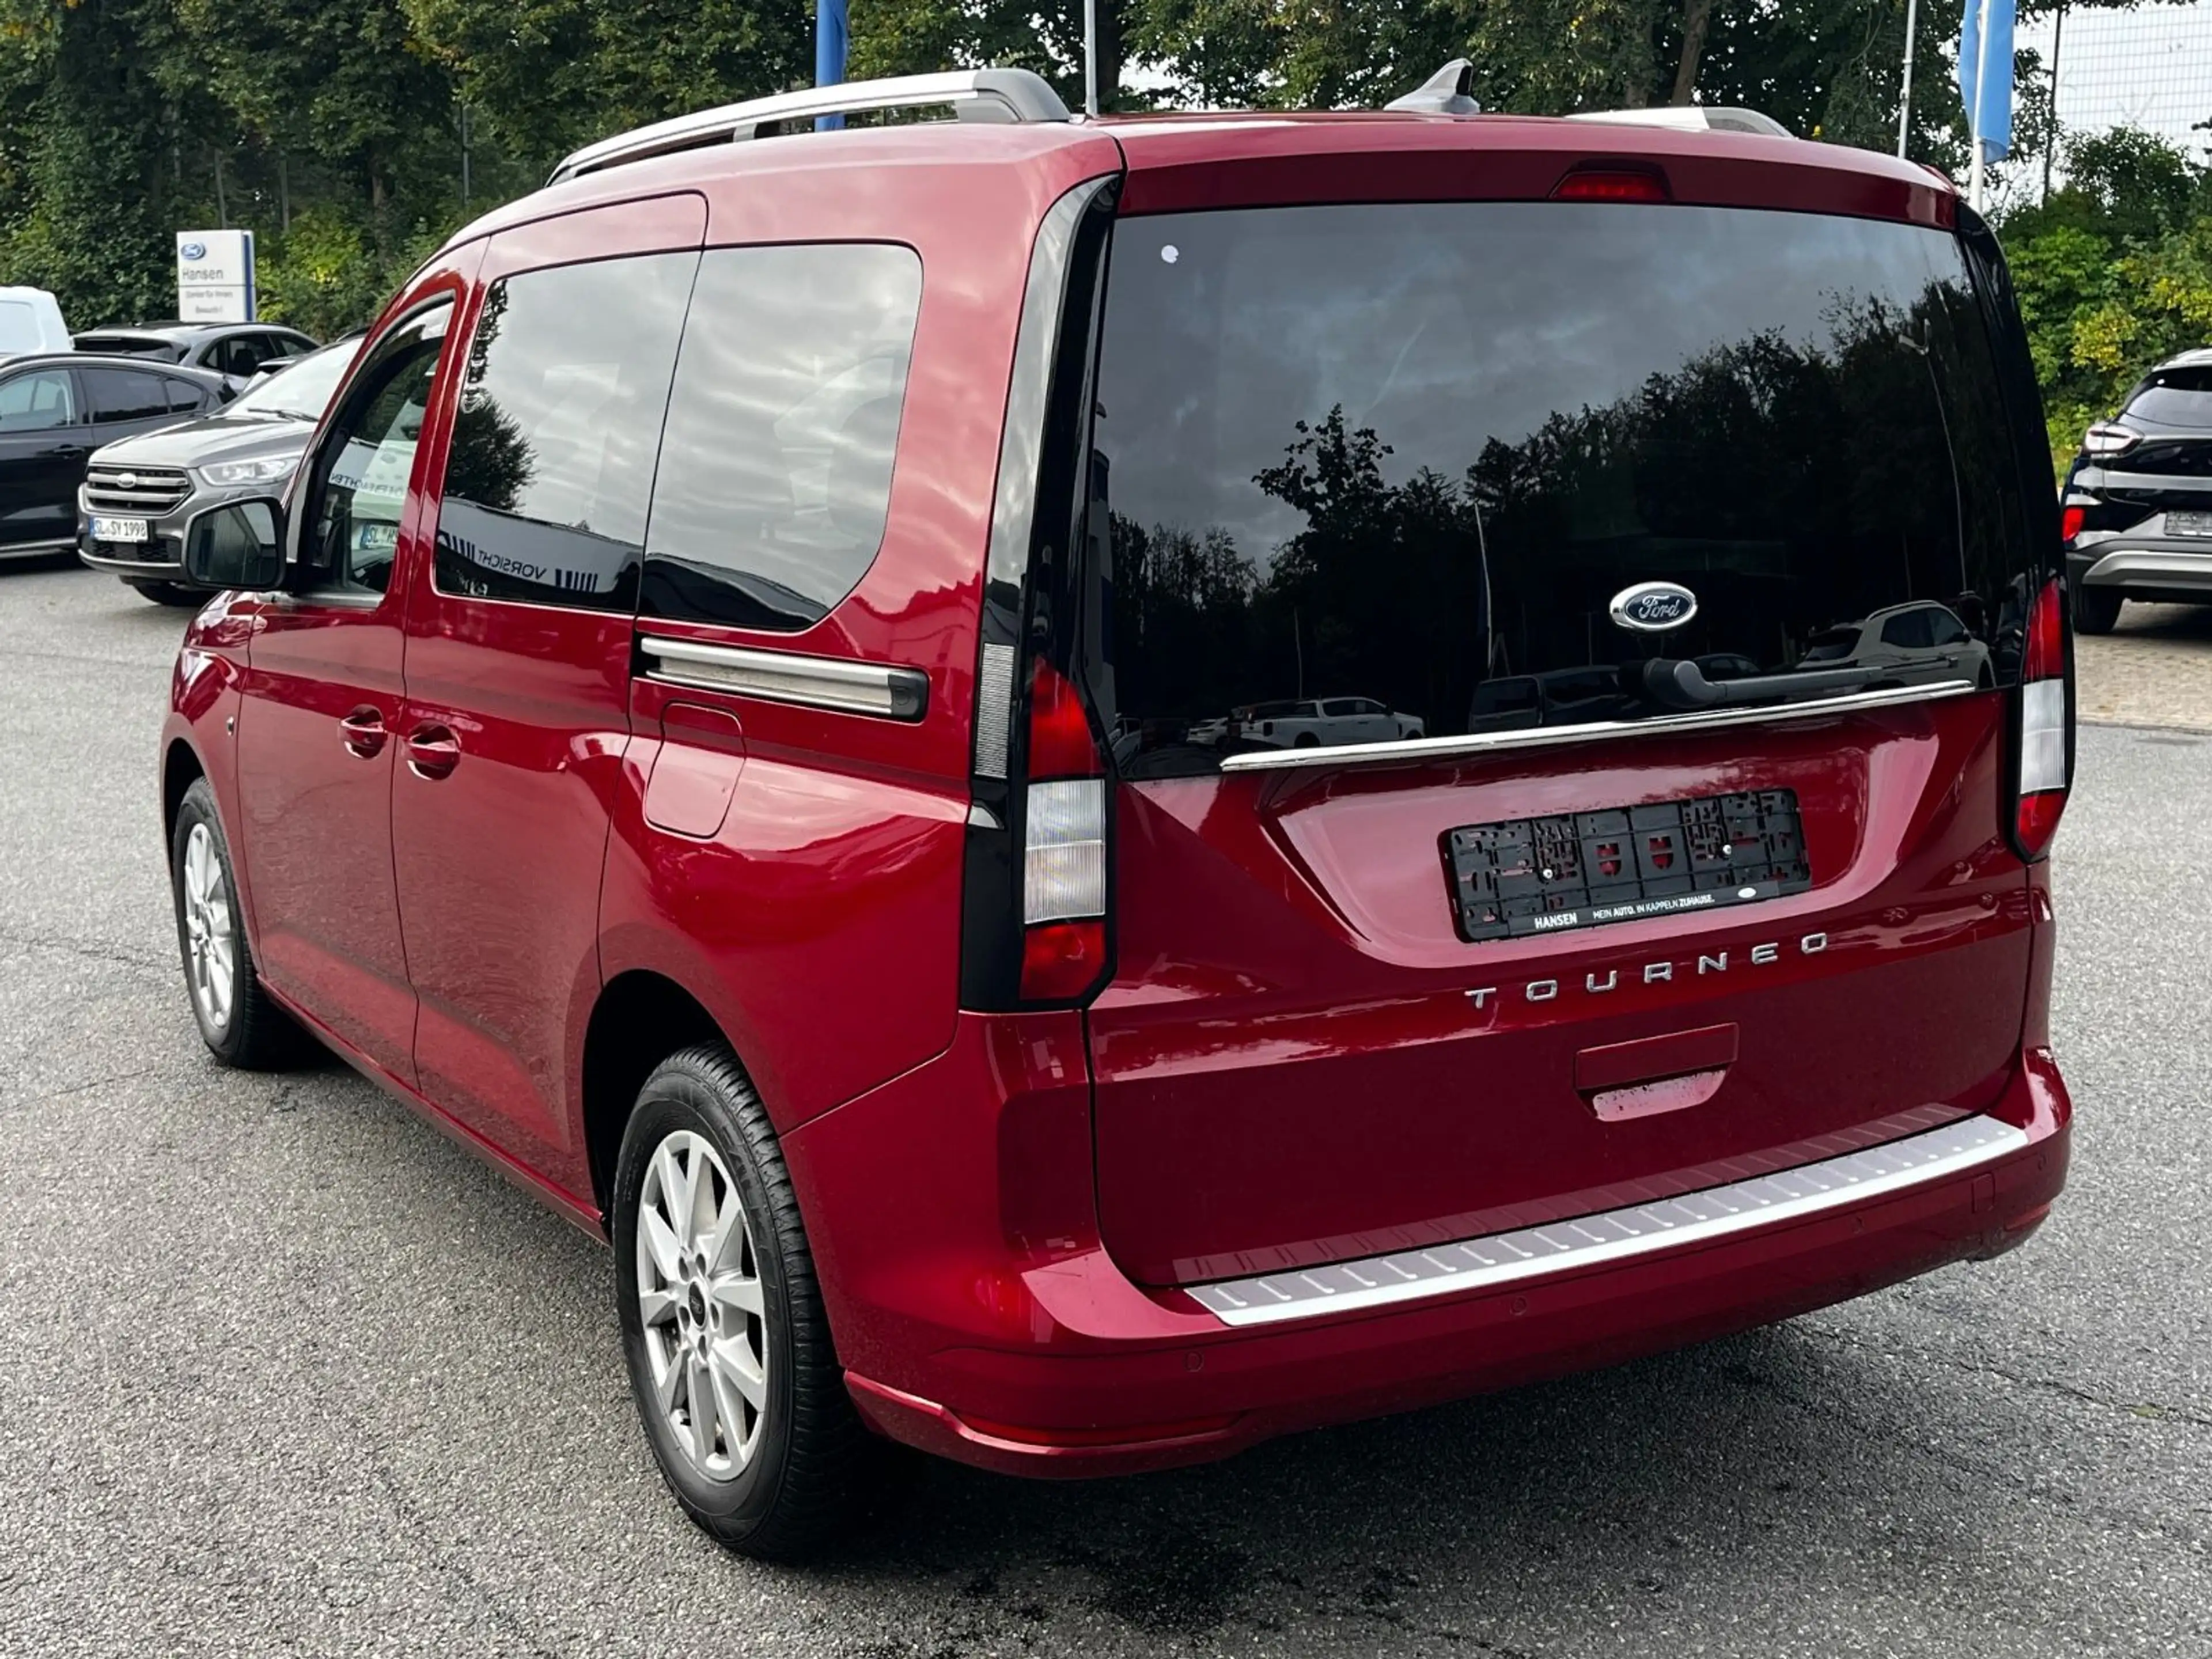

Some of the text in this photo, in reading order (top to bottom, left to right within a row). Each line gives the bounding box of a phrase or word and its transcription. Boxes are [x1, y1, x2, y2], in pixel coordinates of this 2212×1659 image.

[182, 267, 224, 281] Hansen
[1638, 594, 1681, 619] Ford
[1534, 894, 1715, 930] HANSEN MEIN AUTO. IN KAPPELN ZUHAUSE.
[1464, 932, 1828, 1009] TOURNEO
